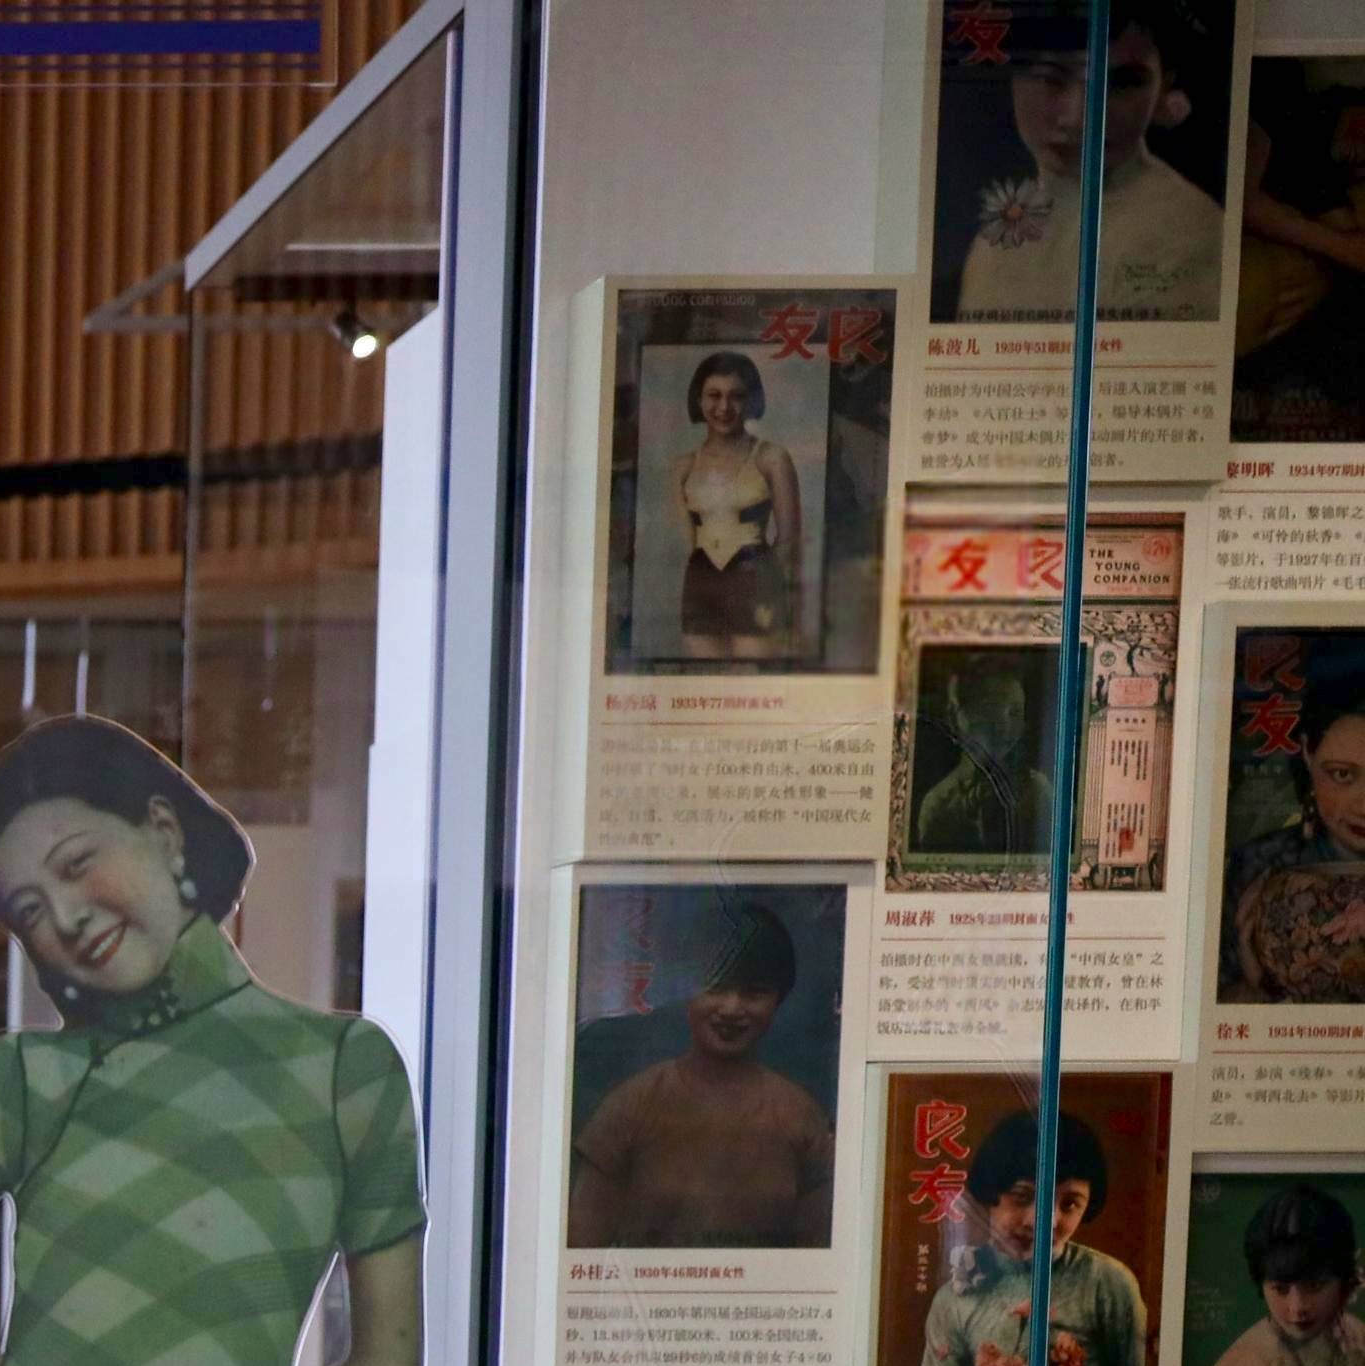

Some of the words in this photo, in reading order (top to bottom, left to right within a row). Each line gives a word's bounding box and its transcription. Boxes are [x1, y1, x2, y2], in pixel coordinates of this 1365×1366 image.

[995, 339, 1123, 354] 1930年51期封女性
[1089, 548, 1114, 559] THE
[1095, 561, 1141, 571] YOUNG
[1094, 574, 1171, 584] COMPANION
[1269, 1024, 1365, 1039] 1934年100期封面
[908, 1100, 970, 1224] 良友
